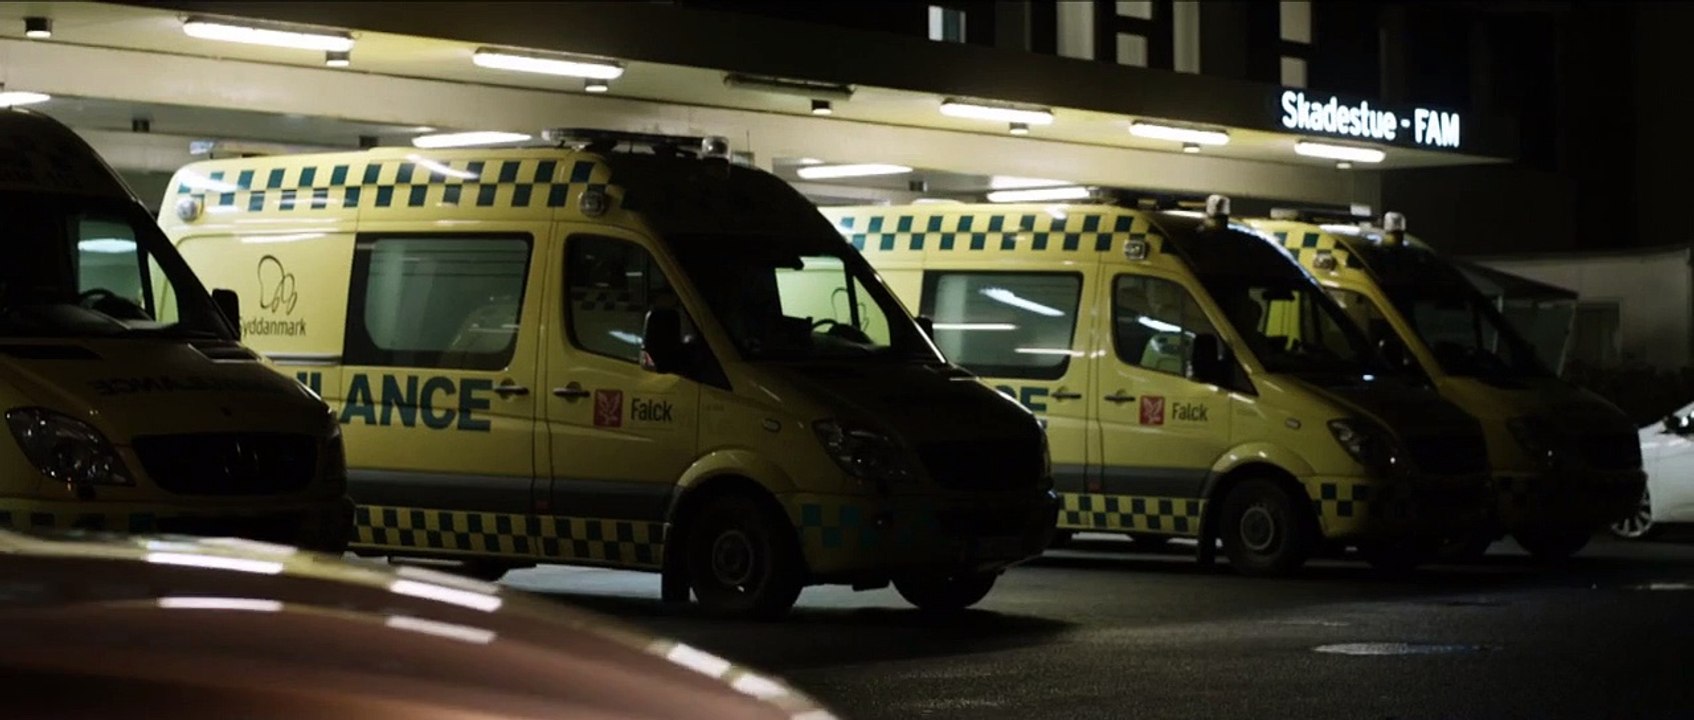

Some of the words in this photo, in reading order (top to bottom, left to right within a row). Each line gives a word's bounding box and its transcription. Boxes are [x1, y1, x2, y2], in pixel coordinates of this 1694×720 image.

[1281, 90, 1397, 141] Skadestue
[1414, 108, 1460, 148] FAM
[239, 317, 306, 338] yddanmark
[297, 371, 493, 432] ANCE
[631, 398, 674, 422] Falck
[1172, 402, 1208, 422] Falck
